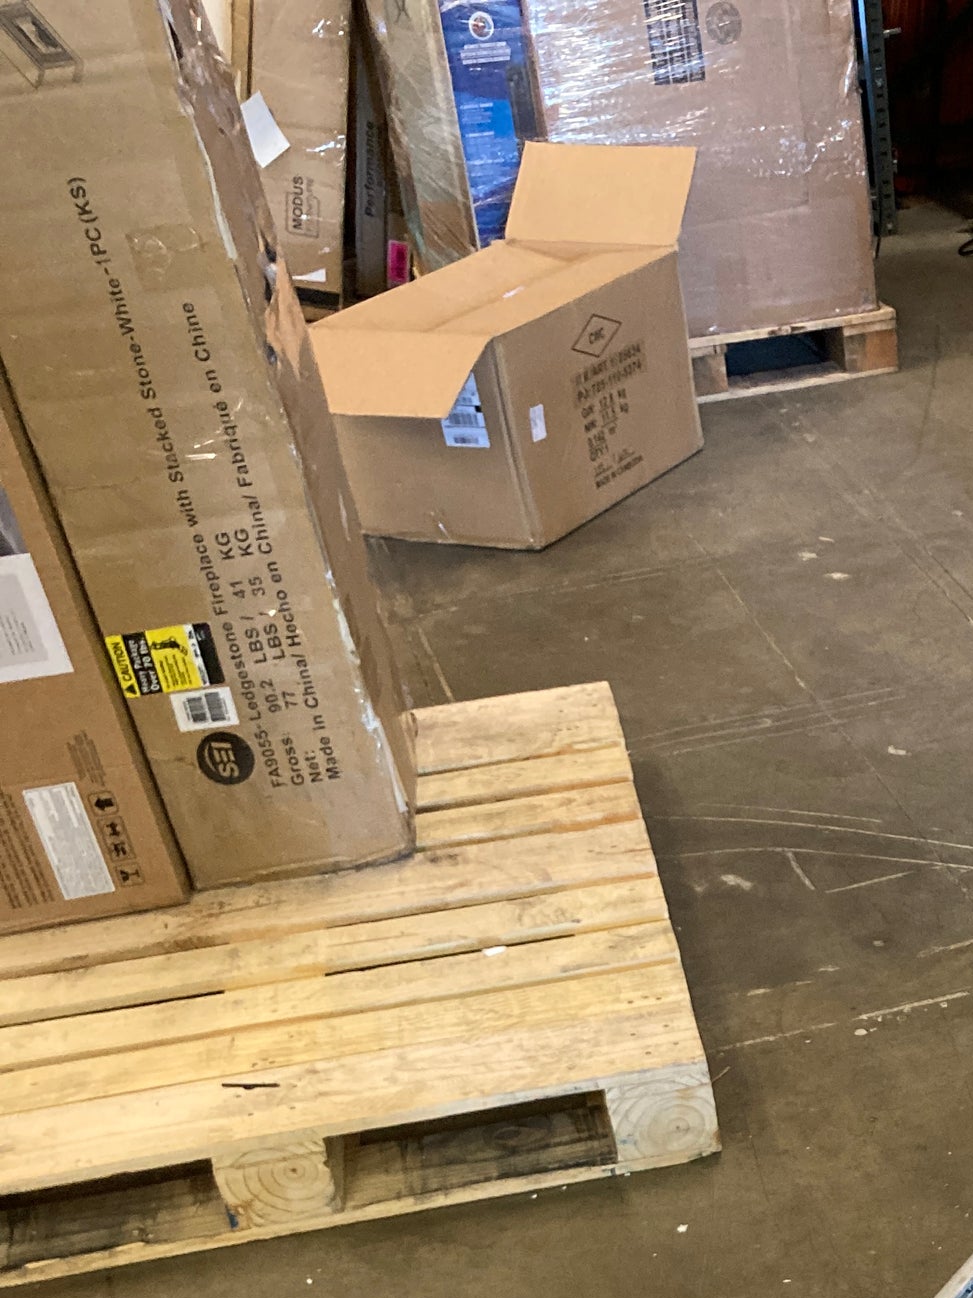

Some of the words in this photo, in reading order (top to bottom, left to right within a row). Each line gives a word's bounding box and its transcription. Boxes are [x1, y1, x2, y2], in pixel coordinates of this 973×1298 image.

[363, 121, 378, 217] Performance
[291, 176, 304, 230] MODUS
[182, 302, 211, 361] Chine
[205, 370, 222, 393] en
[148, 407, 184, 483] Stacked
[176, 489, 199, 527] with
[242, 495, 273, 554] China/
[215, 532, 235, 561] KG
[234, 528, 254, 557] KG
[193, 534, 228, 616] Fireplace
[229, 580, 246, 599] 41
[248, 576, 266, 597] 35
[267, 561, 282, 583] en
[276, 590, 301, 647] Hecho
[245, 627, 267, 664] LBS
[263, 623, 286, 660] LBS
[111, 641, 133, 682] CAUTION
[149, 670, 160, 691] Over
[260, 678, 282, 714] 90.2
[290, 652, 319, 709] China/
[281, 691, 299, 710] 77
[208, 741, 241, 778] SEI
[304, 750, 323, 784] Net:
[319, 737, 341, 780] Made
